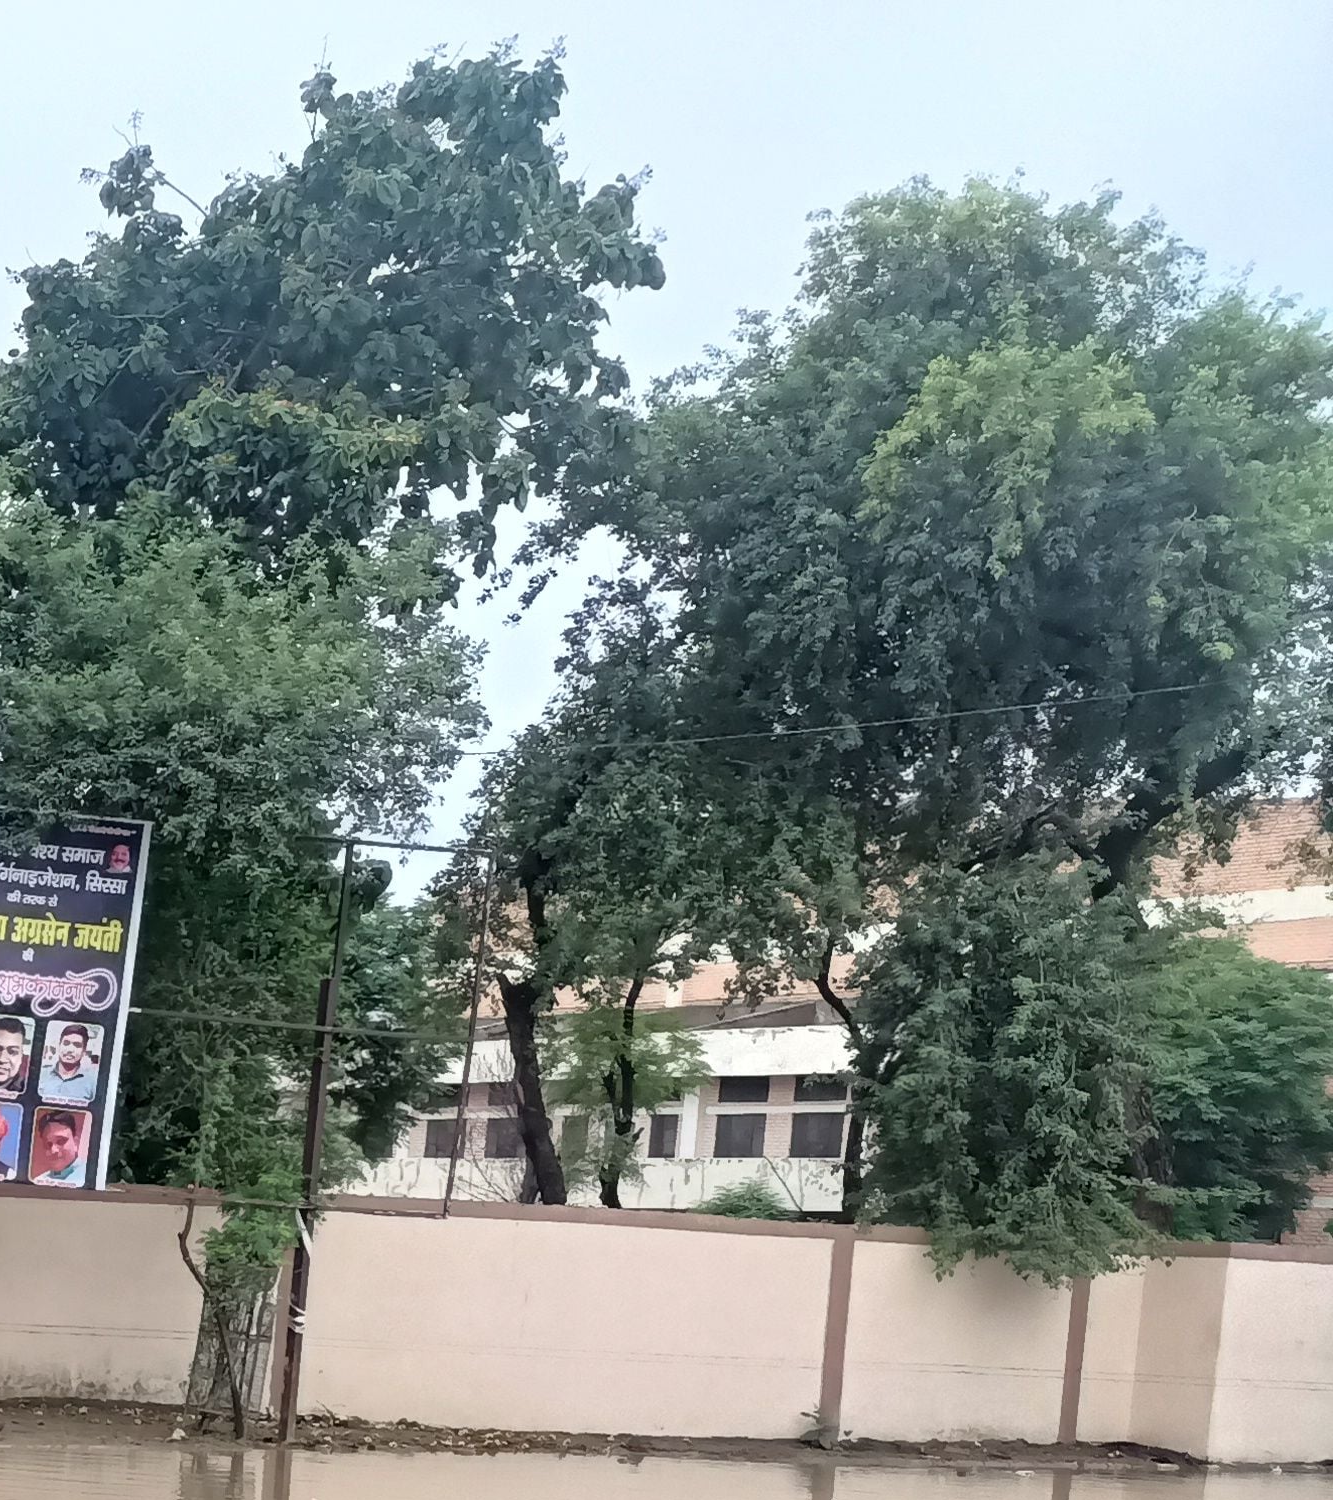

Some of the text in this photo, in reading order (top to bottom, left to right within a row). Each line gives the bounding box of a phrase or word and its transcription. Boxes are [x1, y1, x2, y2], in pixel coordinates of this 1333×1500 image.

[61, 846, 106, 866] समाज
[6, 890, 20, 903] की
[48, 894, 58, 907] से
[11, 912, 71, 947] अग्रसेन
[73, 917, 124, 952] जयंती
